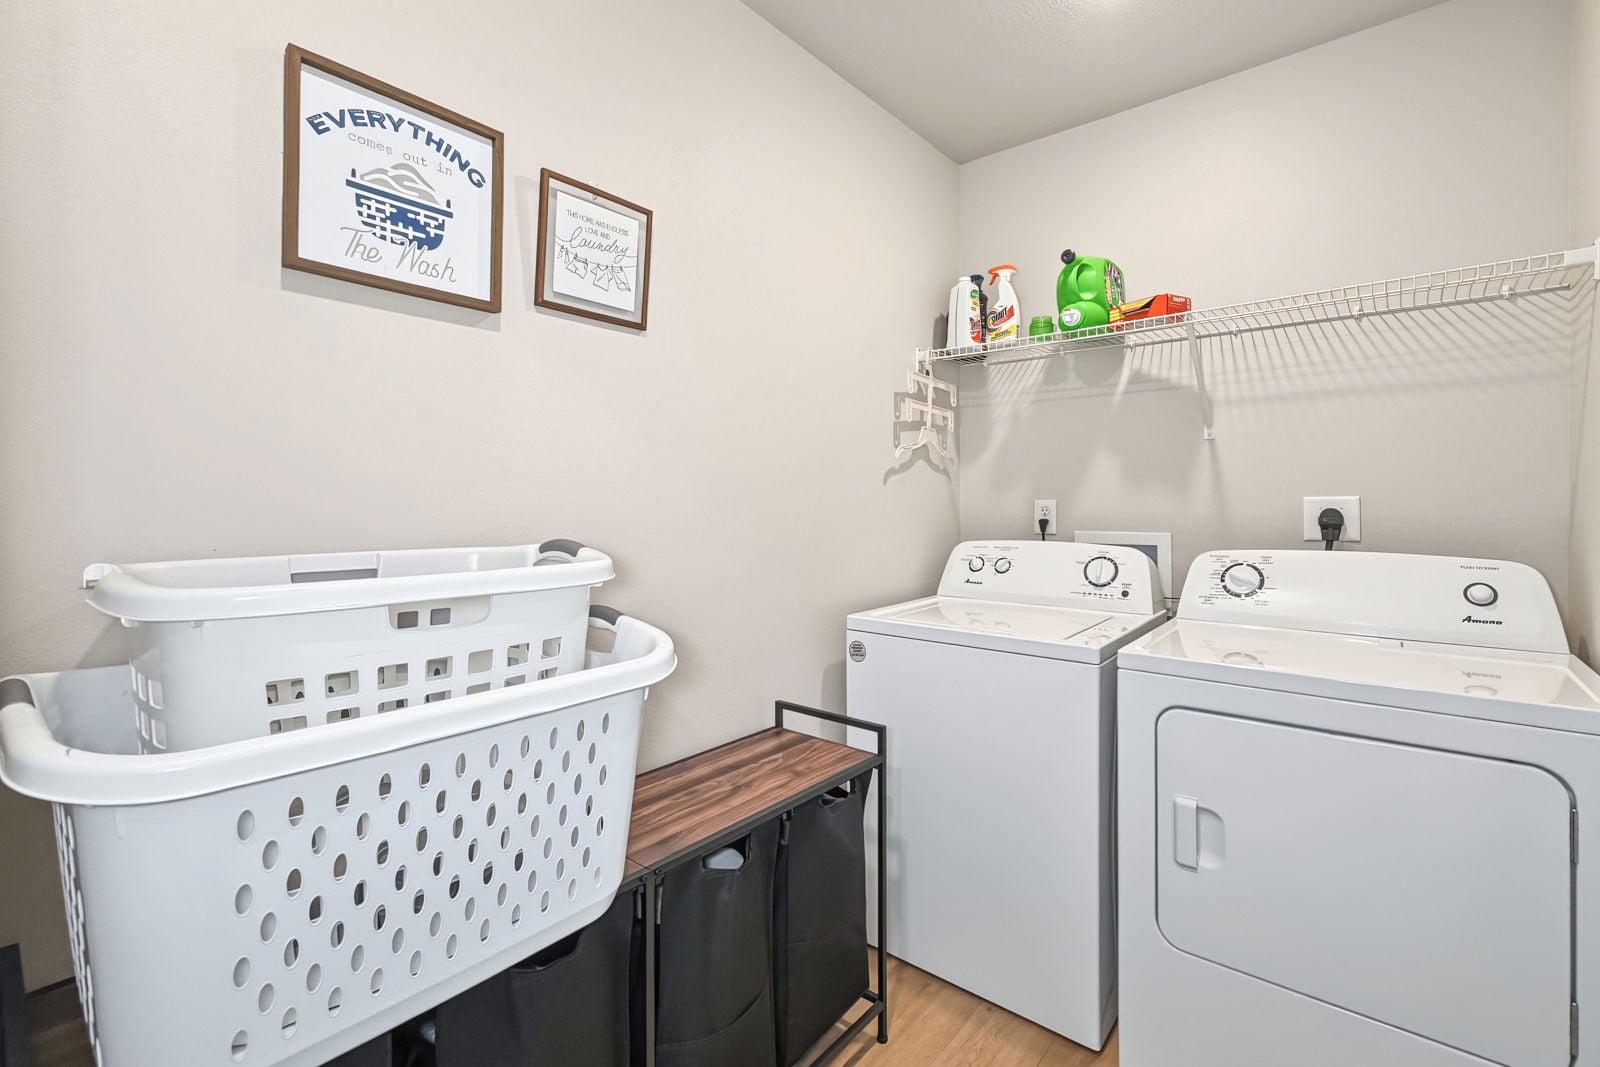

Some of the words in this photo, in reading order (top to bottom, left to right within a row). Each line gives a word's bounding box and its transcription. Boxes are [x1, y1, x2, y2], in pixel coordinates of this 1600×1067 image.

[306, 108, 486, 189] EVERYTHING
[347, 132, 393, 155] comes
[402, 151, 428, 167] out
[436, 162, 453, 177] in
[566, 209, 579, 219] THIS
[584, 226, 599, 237] LOVE
[599, 231, 611, 241] AND
[340, 226, 383, 263] The
[393, 237, 456, 283] Wash
[1461, 615, 1503, 626] Amana
